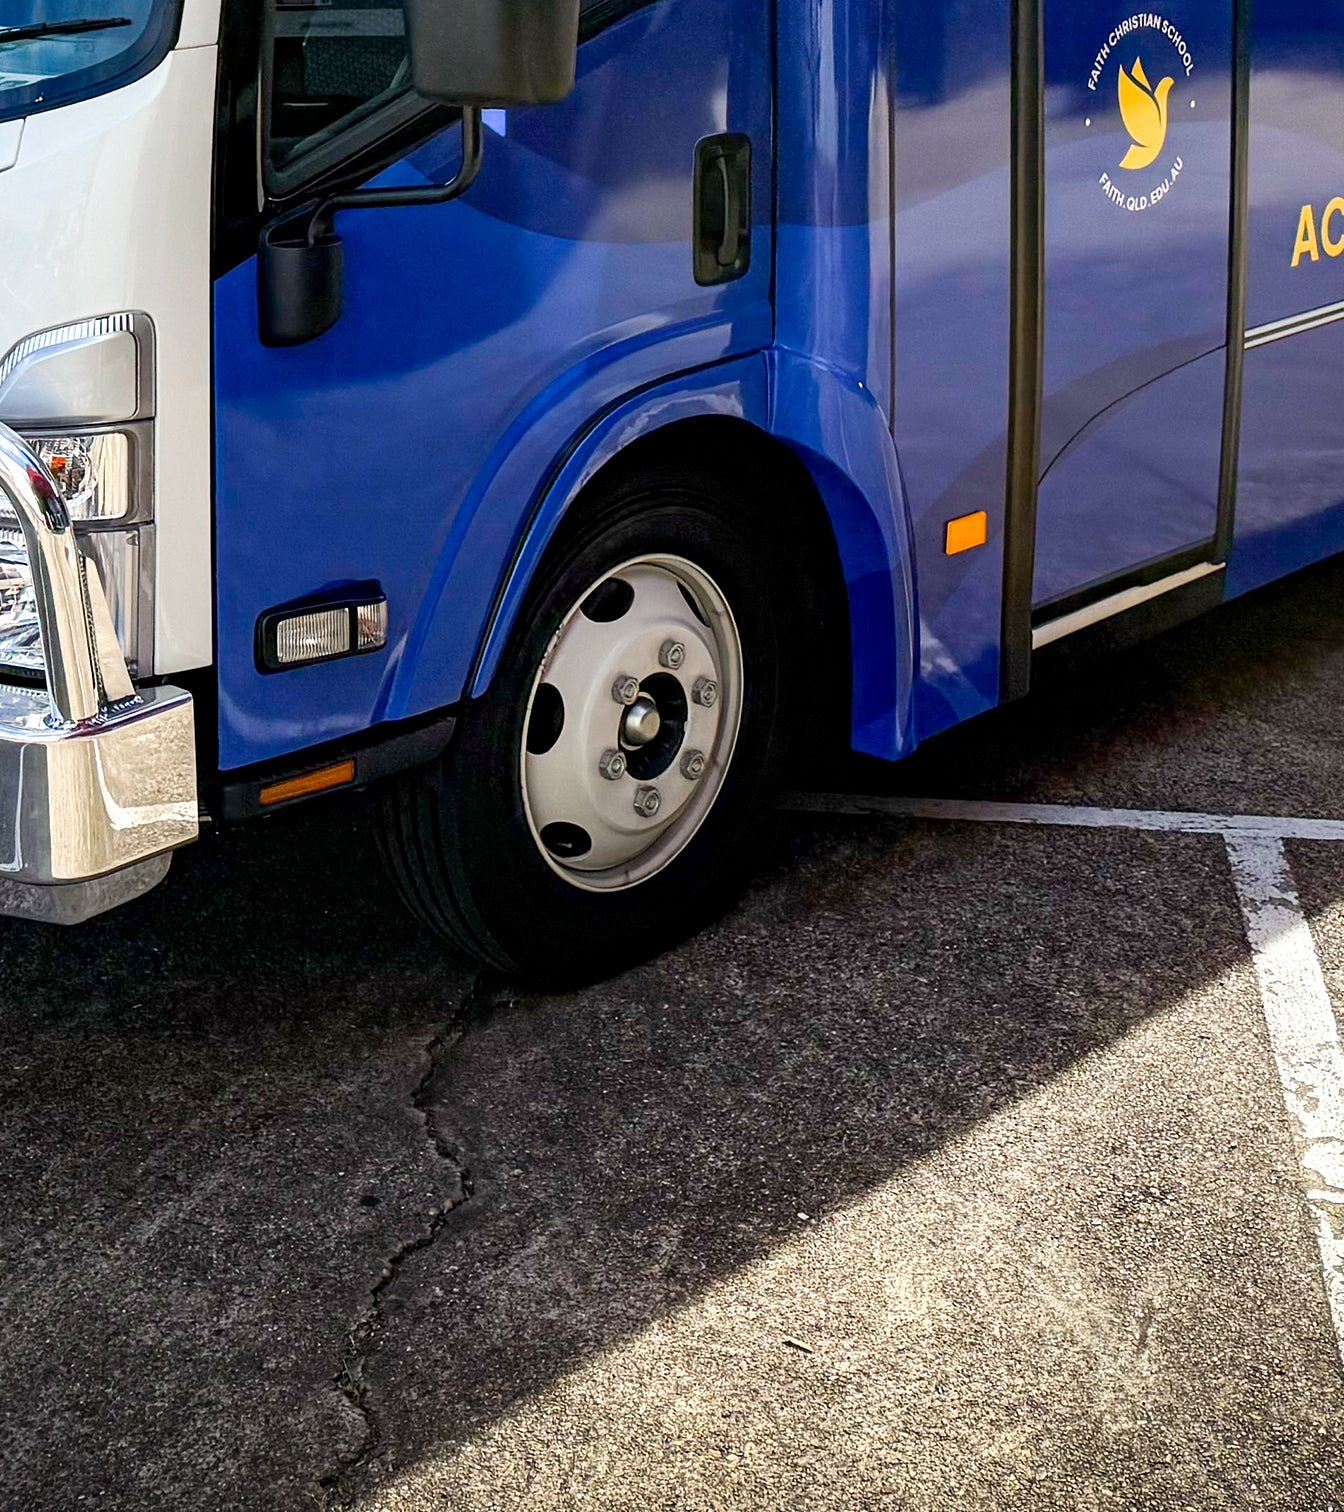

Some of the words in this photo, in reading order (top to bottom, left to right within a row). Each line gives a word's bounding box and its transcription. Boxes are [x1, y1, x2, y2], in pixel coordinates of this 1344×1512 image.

[1088, 43, 1110, 91] FAITH
[1108, 13, 1161, 47] CHRISTIAN
[1161, 20, 1195, 77] SCHOOL
[1099, 157, 1184, 211] FAITH.QLD.EDU.AU
